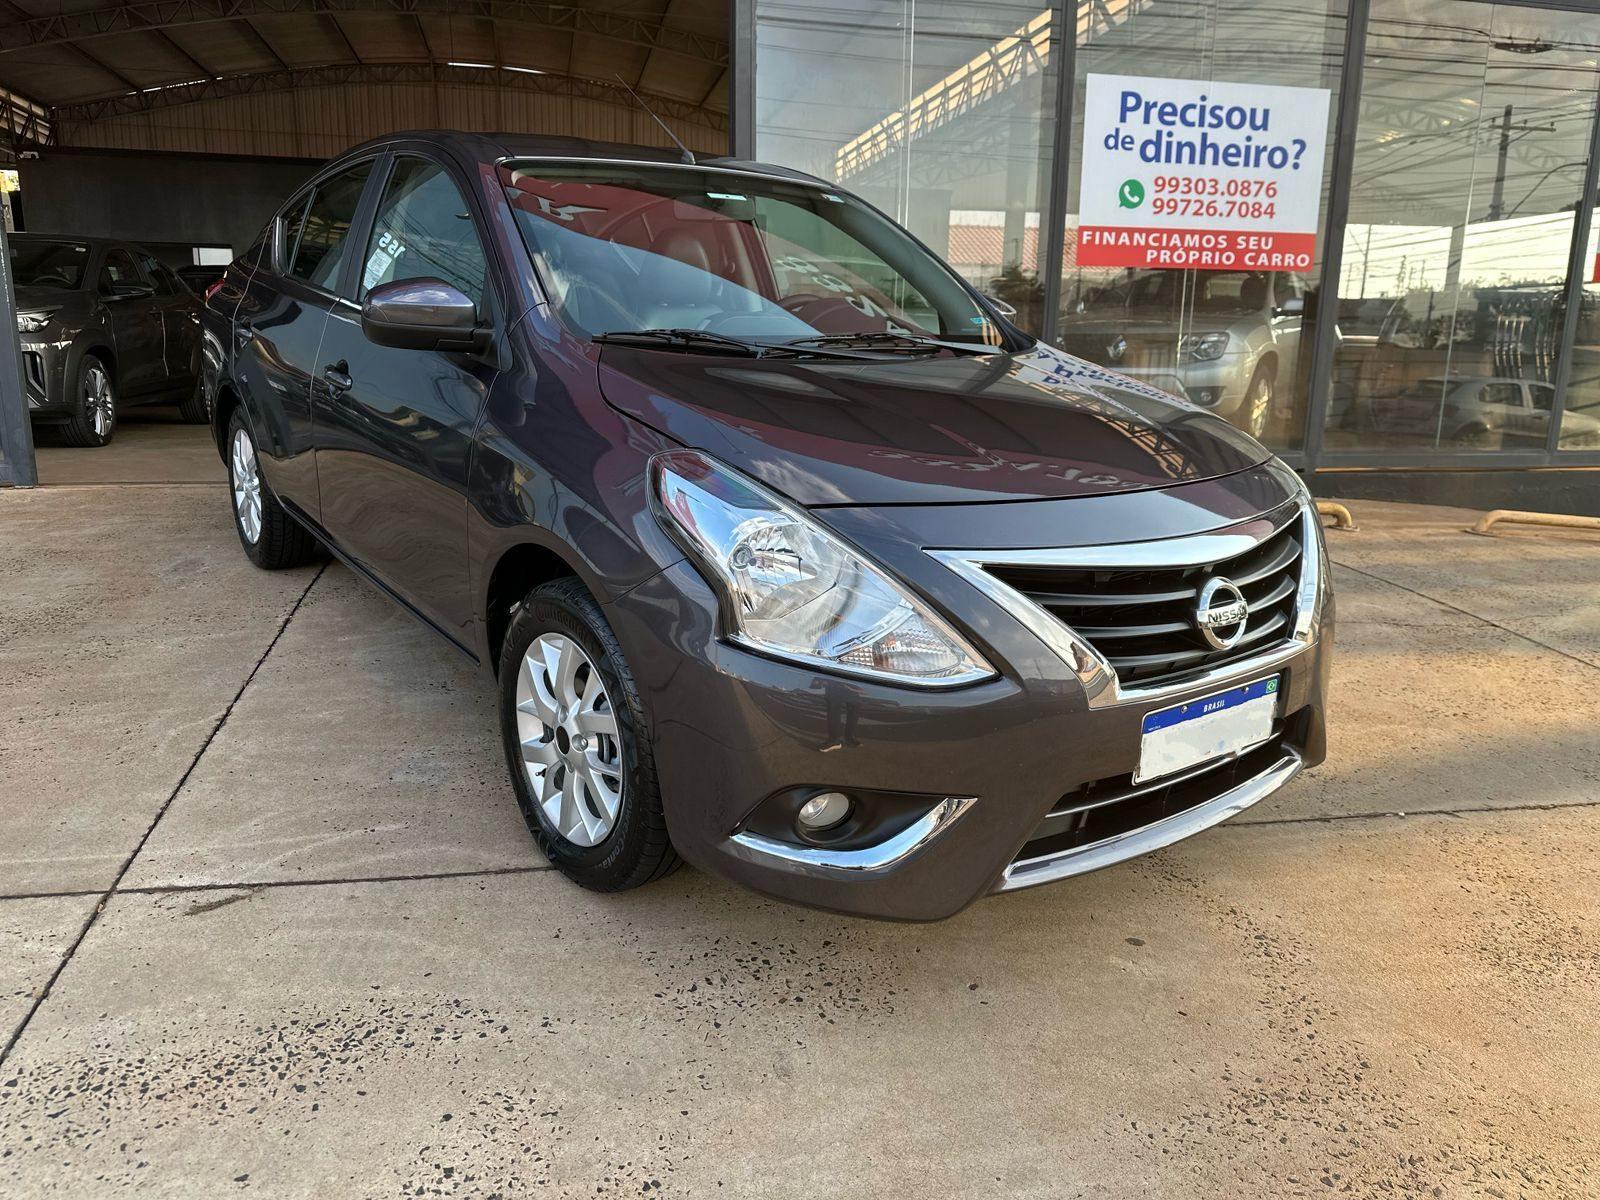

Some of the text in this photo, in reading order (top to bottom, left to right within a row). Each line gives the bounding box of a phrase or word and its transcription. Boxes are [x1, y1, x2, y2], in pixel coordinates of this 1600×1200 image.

[1119, 91, 1270, 131] Precisou
[1103, 128, 1307, 170] de dinheiro?
[1153, 175, 1278, 198] 99303.0876
[1152, 197, 1276, 219] 99726.7084
[1081, 230, 1274, 250] FINANCIAMOS SEU
[1145, 247, 1311, 267] PRÓPRIO CARRO
[1207, 602, 1248, 624] NISSAN
[1203, 699, 1225, 713] BRASIL
